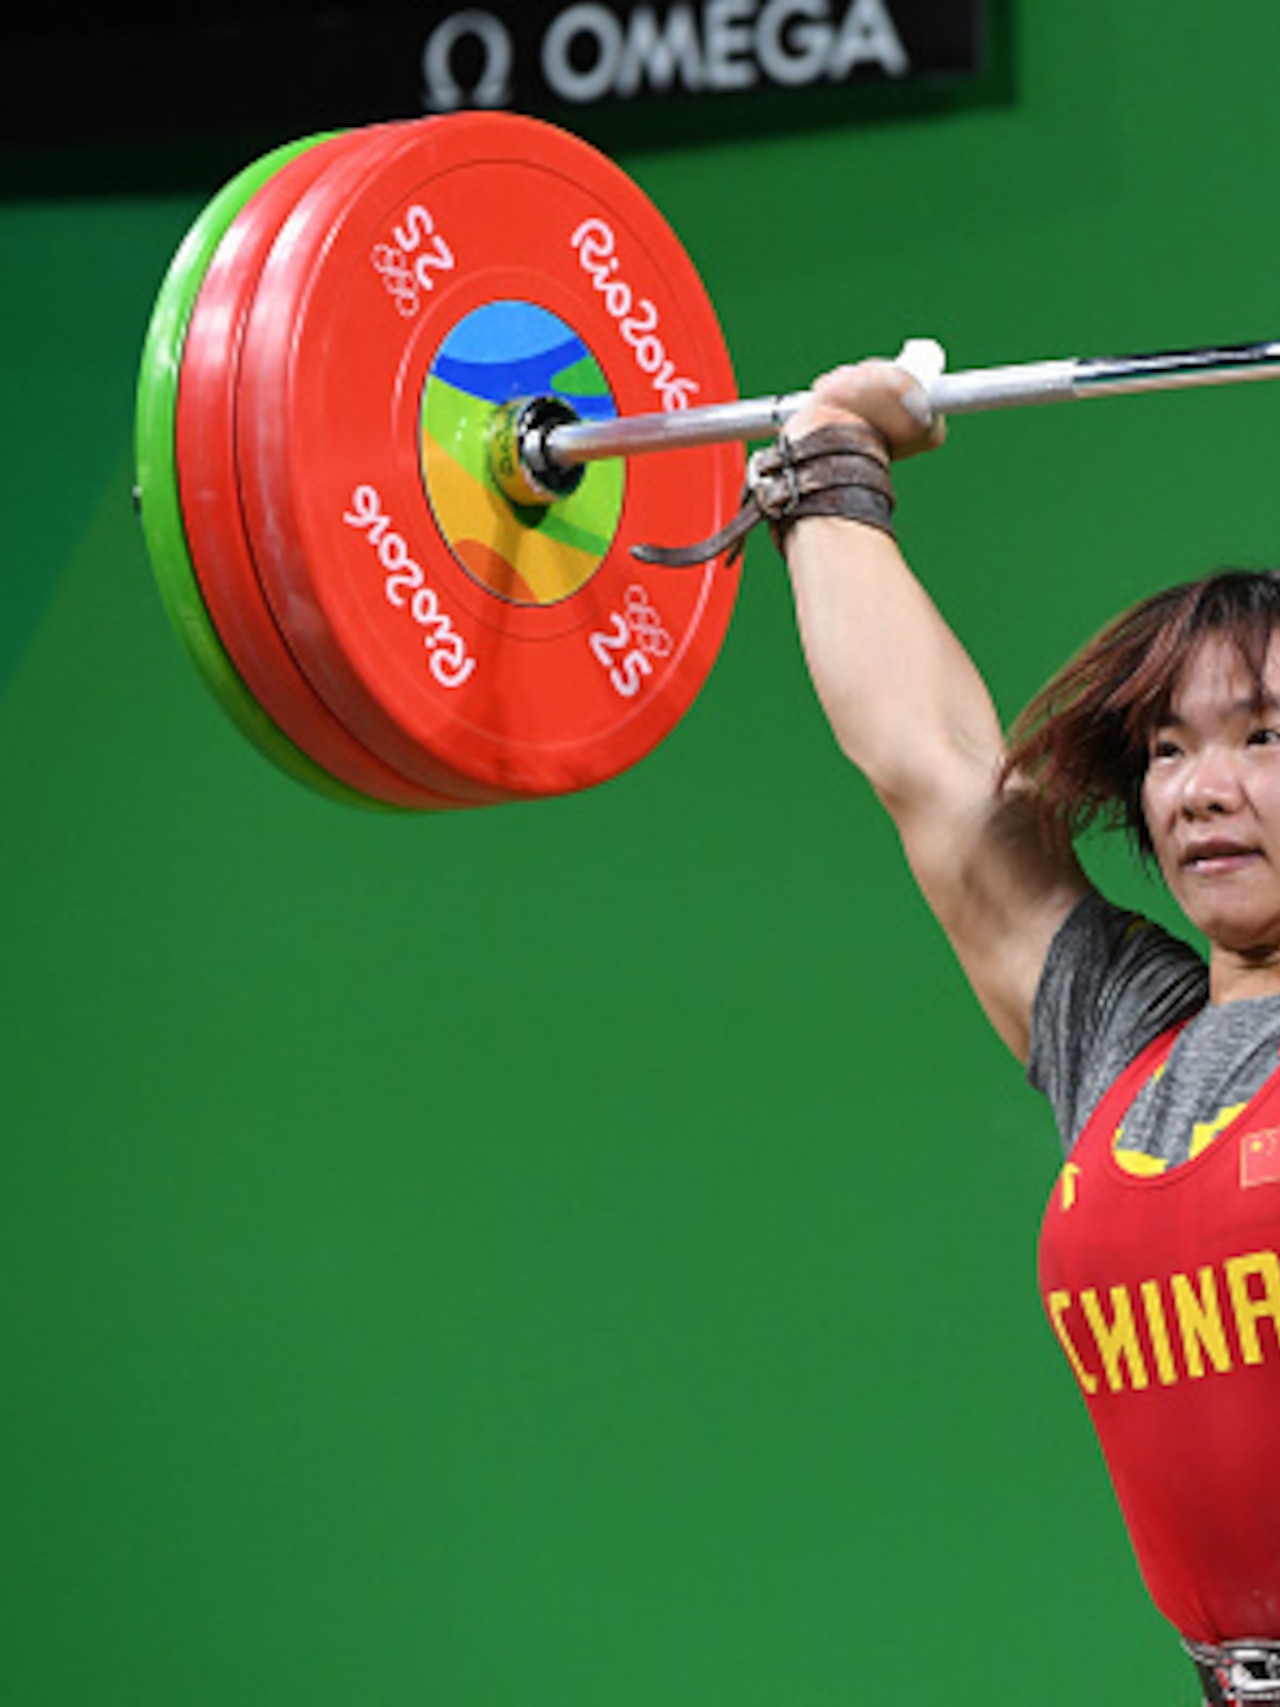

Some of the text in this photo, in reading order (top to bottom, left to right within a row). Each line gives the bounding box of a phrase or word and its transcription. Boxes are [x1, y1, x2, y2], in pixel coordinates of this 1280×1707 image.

[540, 0, 908, 101] OMEGA
[393, 204, 455, 291] 25
[570, 217, 700, 413] Rio2016
[342, 484, 477, 689] Rio2016
[588, 610, 653, 697] 25
